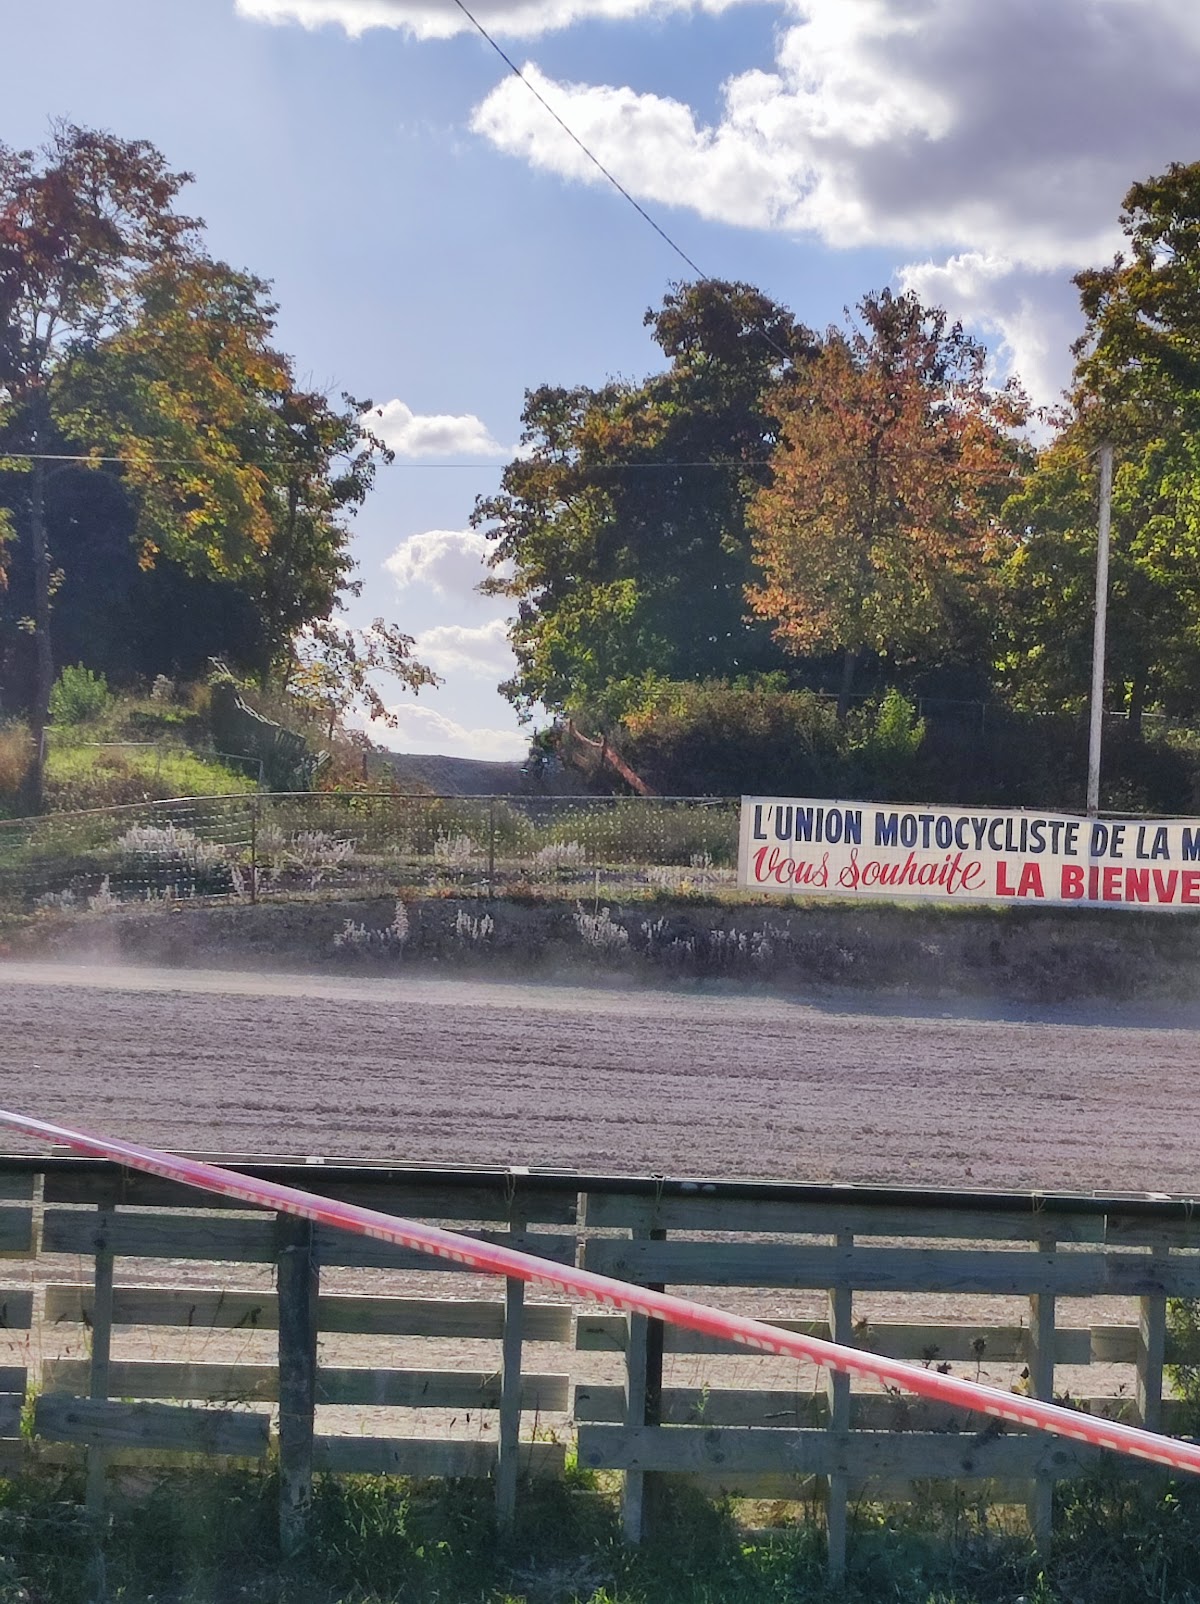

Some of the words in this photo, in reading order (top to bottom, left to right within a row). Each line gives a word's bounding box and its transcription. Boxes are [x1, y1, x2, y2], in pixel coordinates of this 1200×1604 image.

[753, 804, 863, 845] L'UNION
[874, 811, 1080, 856] MOTOCYCLISTE
[1090, 823, 1126, 858] DE
[1136, 826, 1170, 860] LA
[752, 845, 829, 888] Vous
[995, 860, 1045, 898] LA
[1060, 864, 1200, 904] BIENVE
